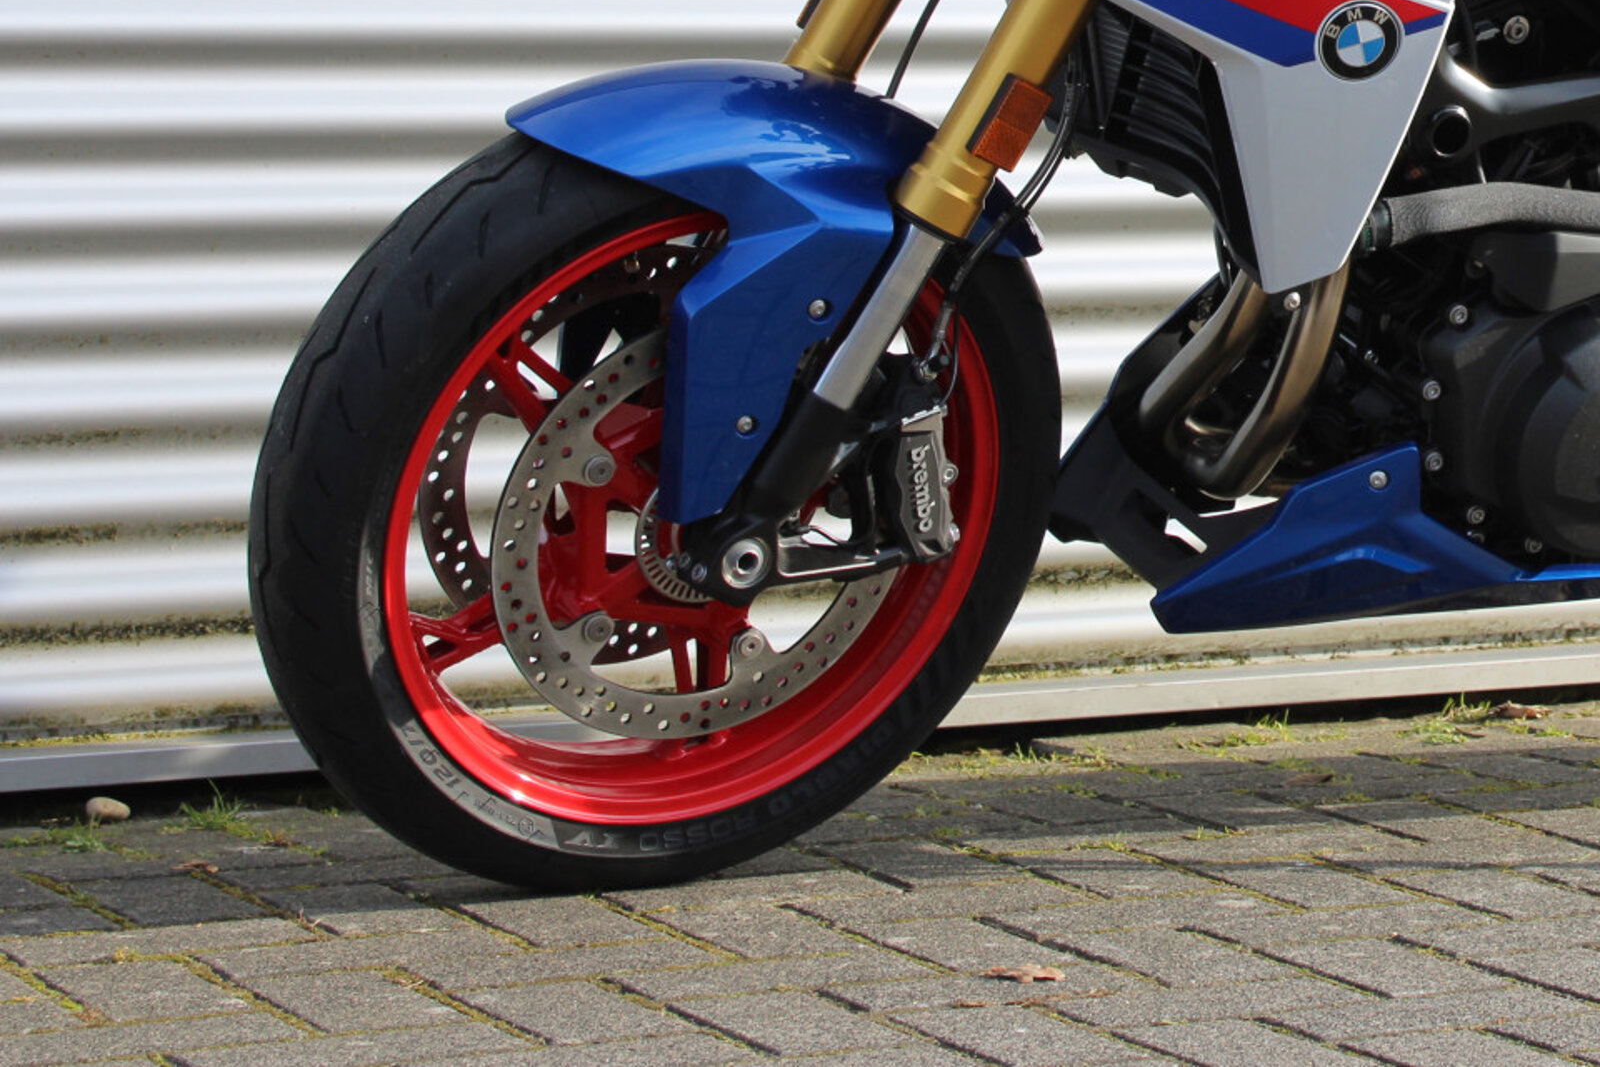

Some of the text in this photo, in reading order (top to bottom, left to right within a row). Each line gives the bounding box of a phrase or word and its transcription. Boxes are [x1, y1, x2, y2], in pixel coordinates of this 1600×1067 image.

[1326, 7, 1390, 39] BMW
[911, 444, 936, 533] brembo
[639, 810, 757, 852] ROSSO
